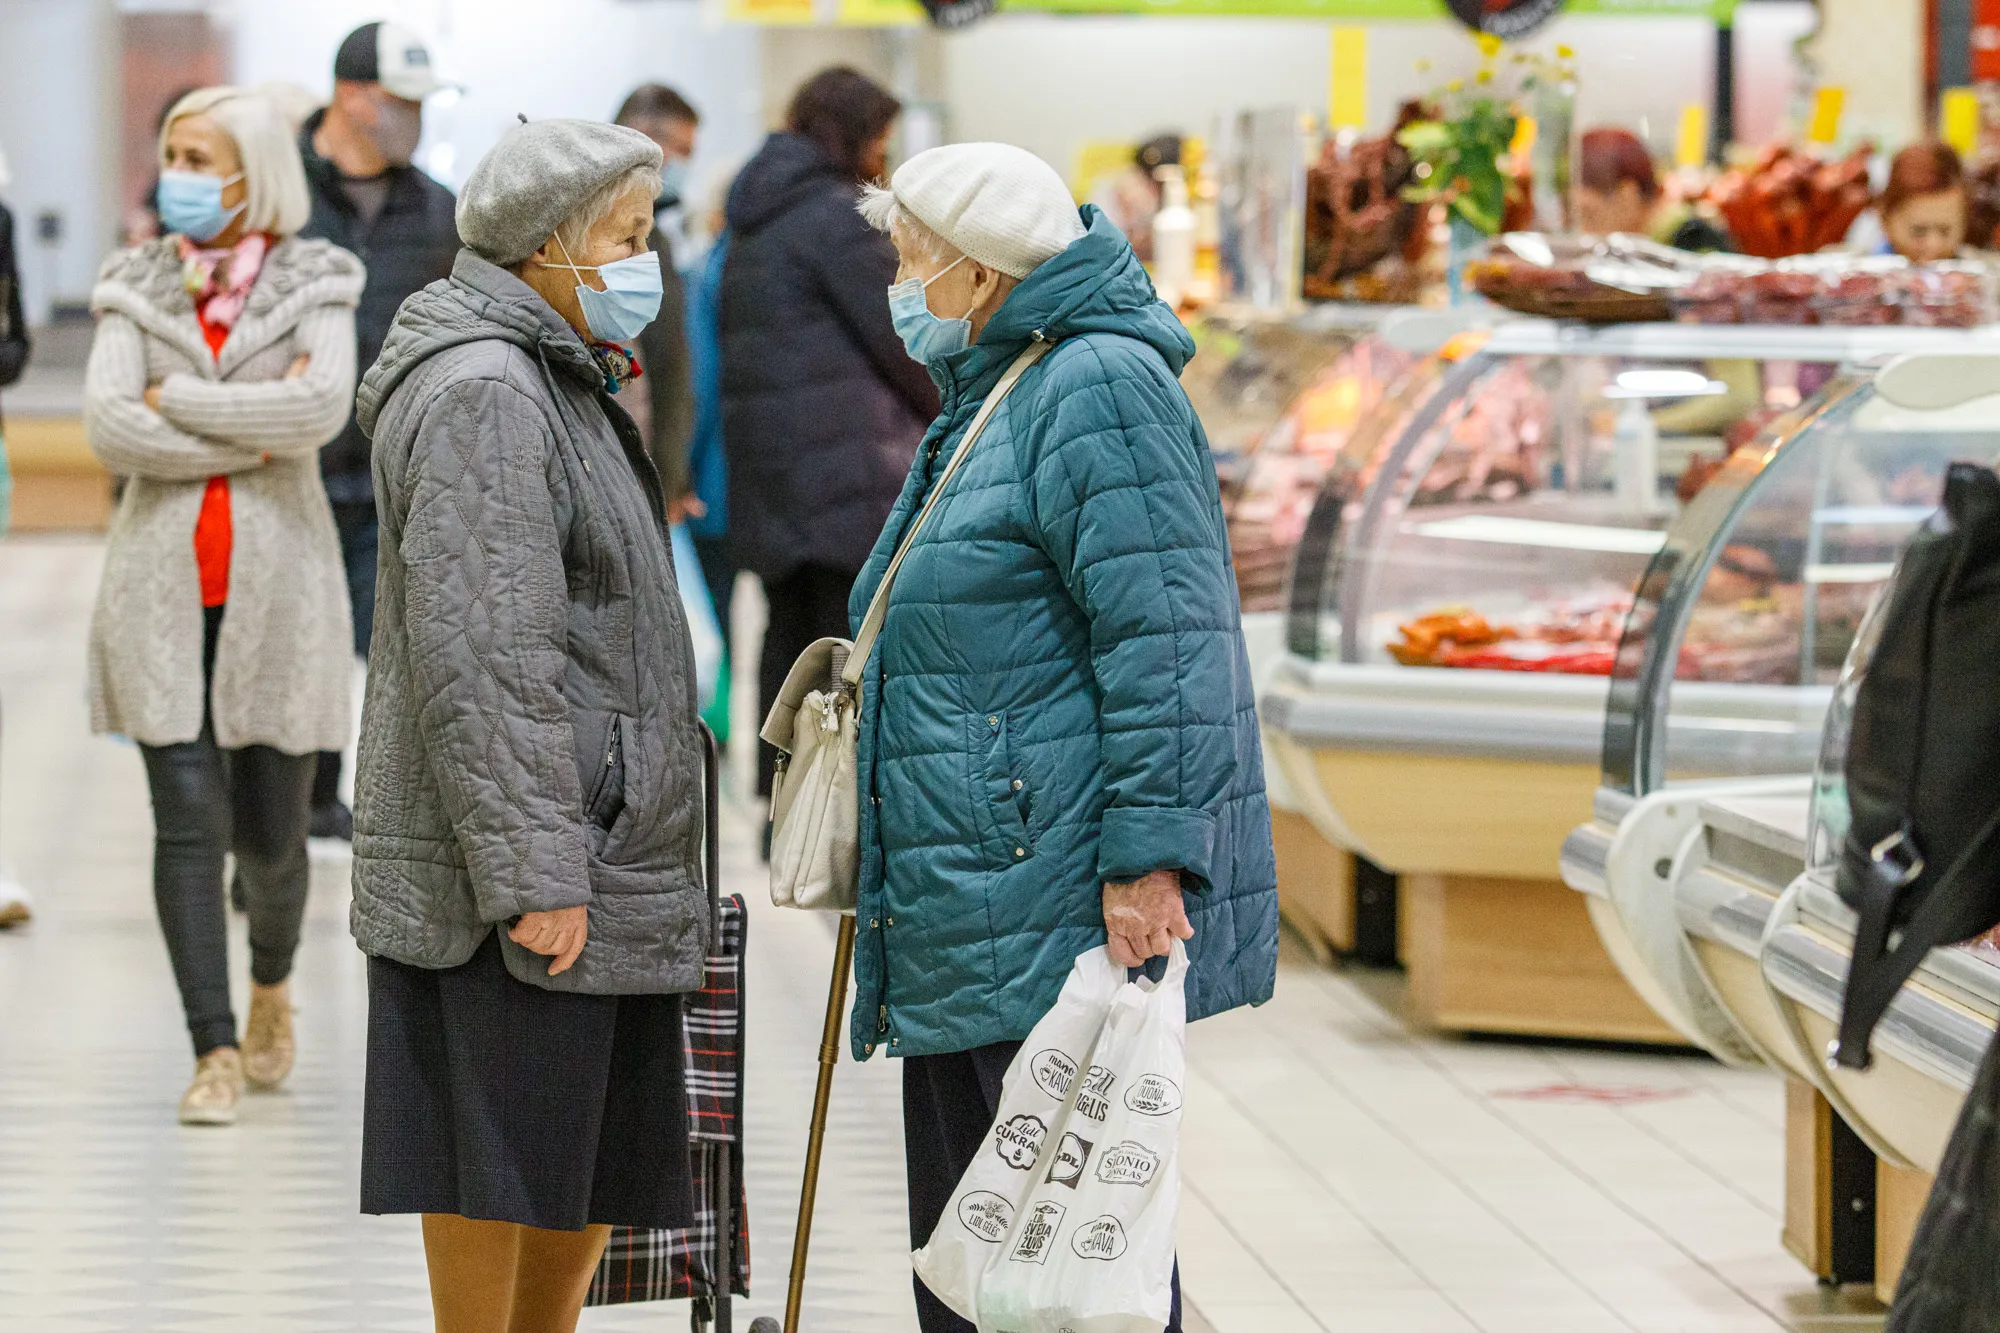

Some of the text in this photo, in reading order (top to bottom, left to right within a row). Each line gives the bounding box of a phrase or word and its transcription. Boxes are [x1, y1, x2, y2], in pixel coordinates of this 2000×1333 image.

[1048, 1054, 1075, 1076] mano
[1015, 1122, 1041, 1138] Lidl
[968, 1213, 984, 1230] LIDL
